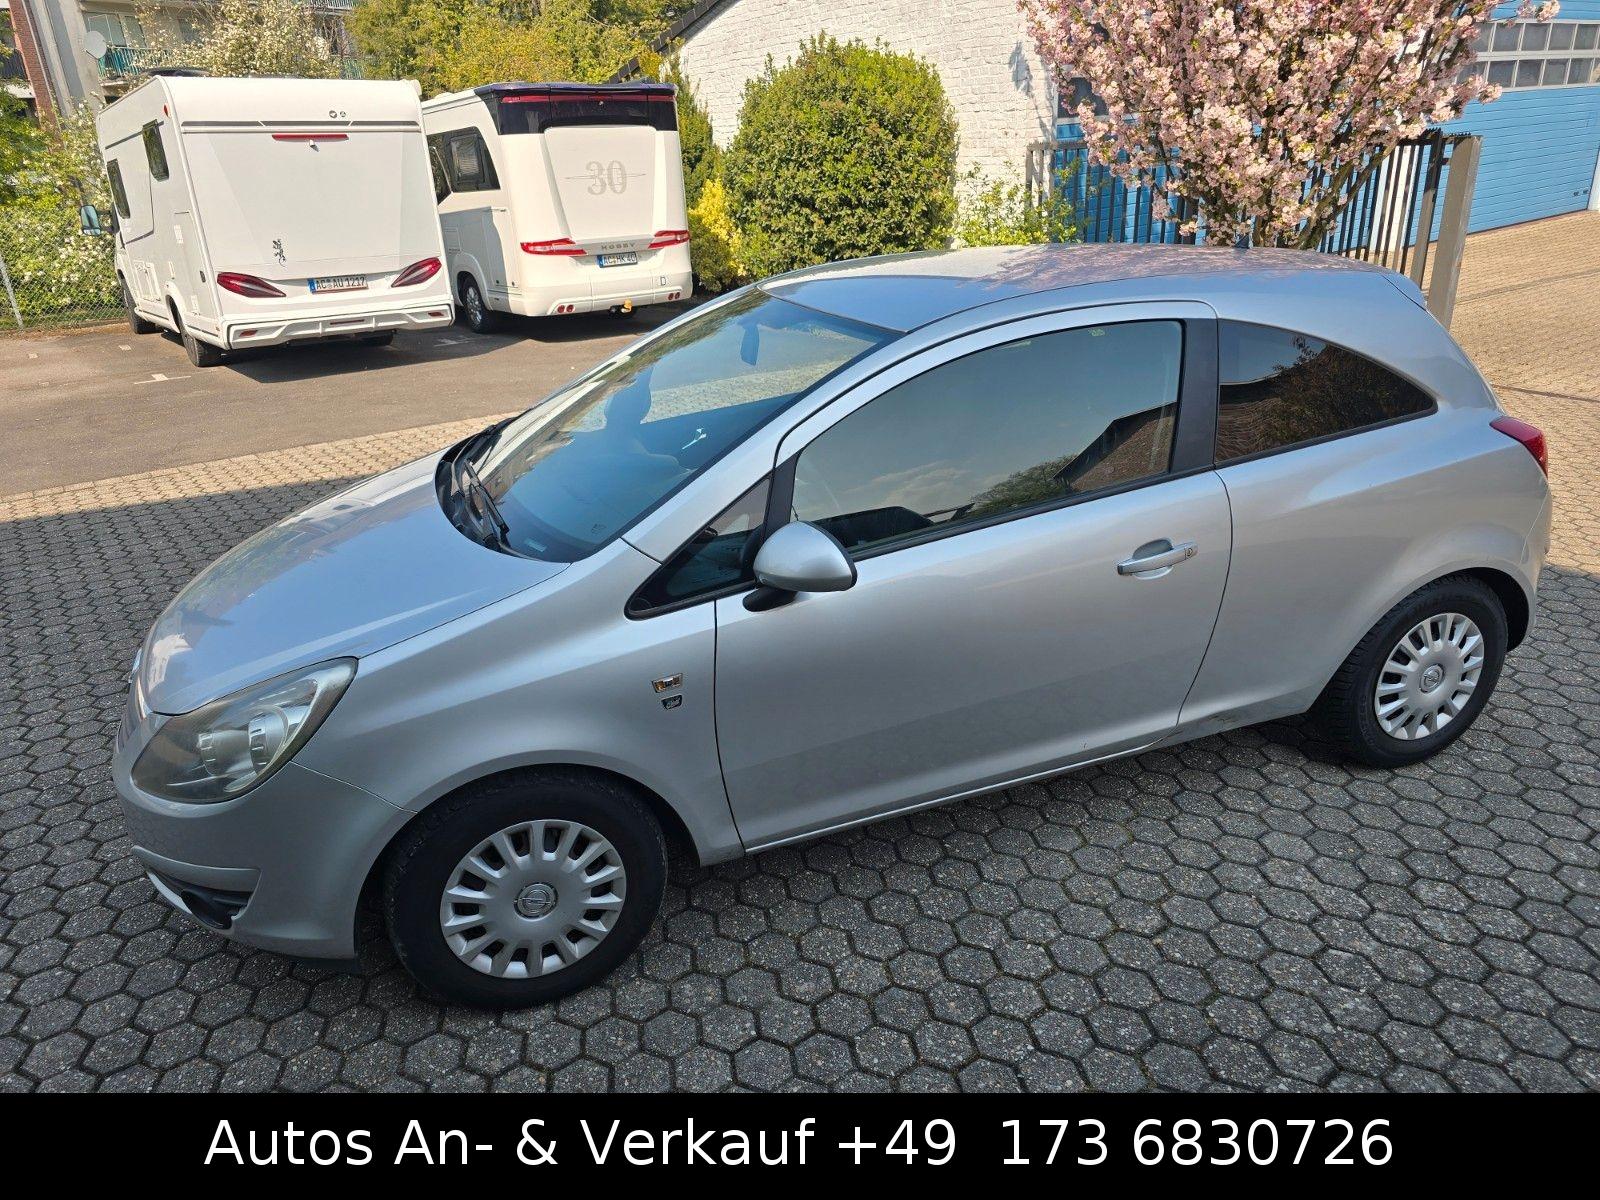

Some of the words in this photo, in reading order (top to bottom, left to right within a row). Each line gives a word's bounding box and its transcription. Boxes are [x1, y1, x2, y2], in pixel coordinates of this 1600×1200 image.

[586, 160, 627, 195] 30
[601, 242, 636, 250] HOBBY
[316, 280, 326, 289] AC
[333, 278, 343, 288] AU
